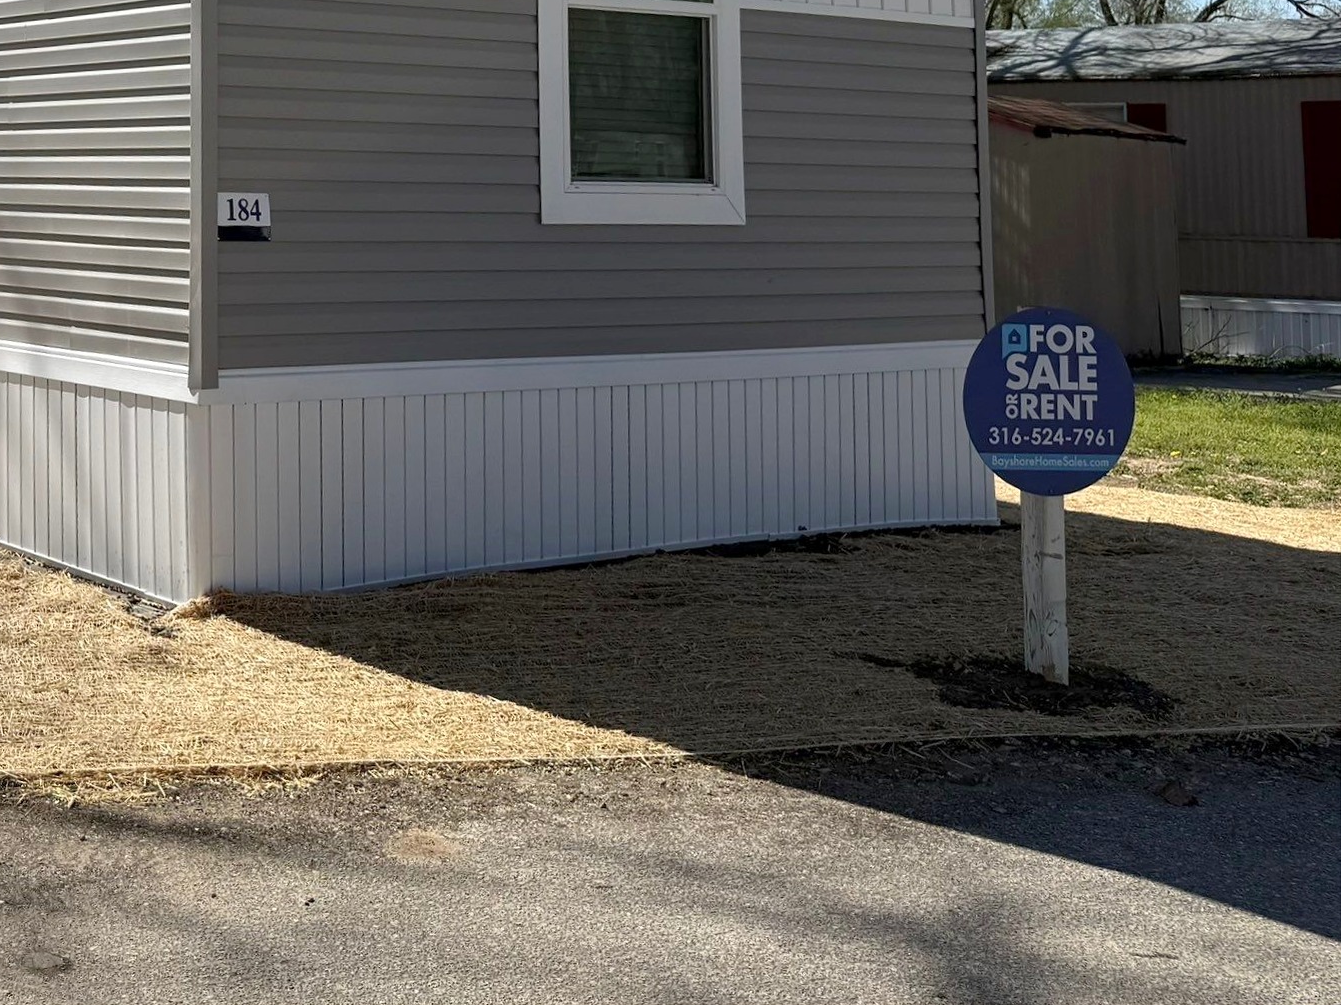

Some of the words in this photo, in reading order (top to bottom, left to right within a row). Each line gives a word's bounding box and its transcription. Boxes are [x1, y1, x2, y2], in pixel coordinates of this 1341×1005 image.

[226, 198, 262, 222] 184
[1029, 324, 1097, 354] FOR
[1005, 353, 1098, 391] SALE
[1005, 393, 1019, 419] OR
[1020, 394, 1098, 421] RENT
[988, 426, 1115, 446] 316-524-7961
[991, 455, 1110, 469] BayshoreHomeSales.com
